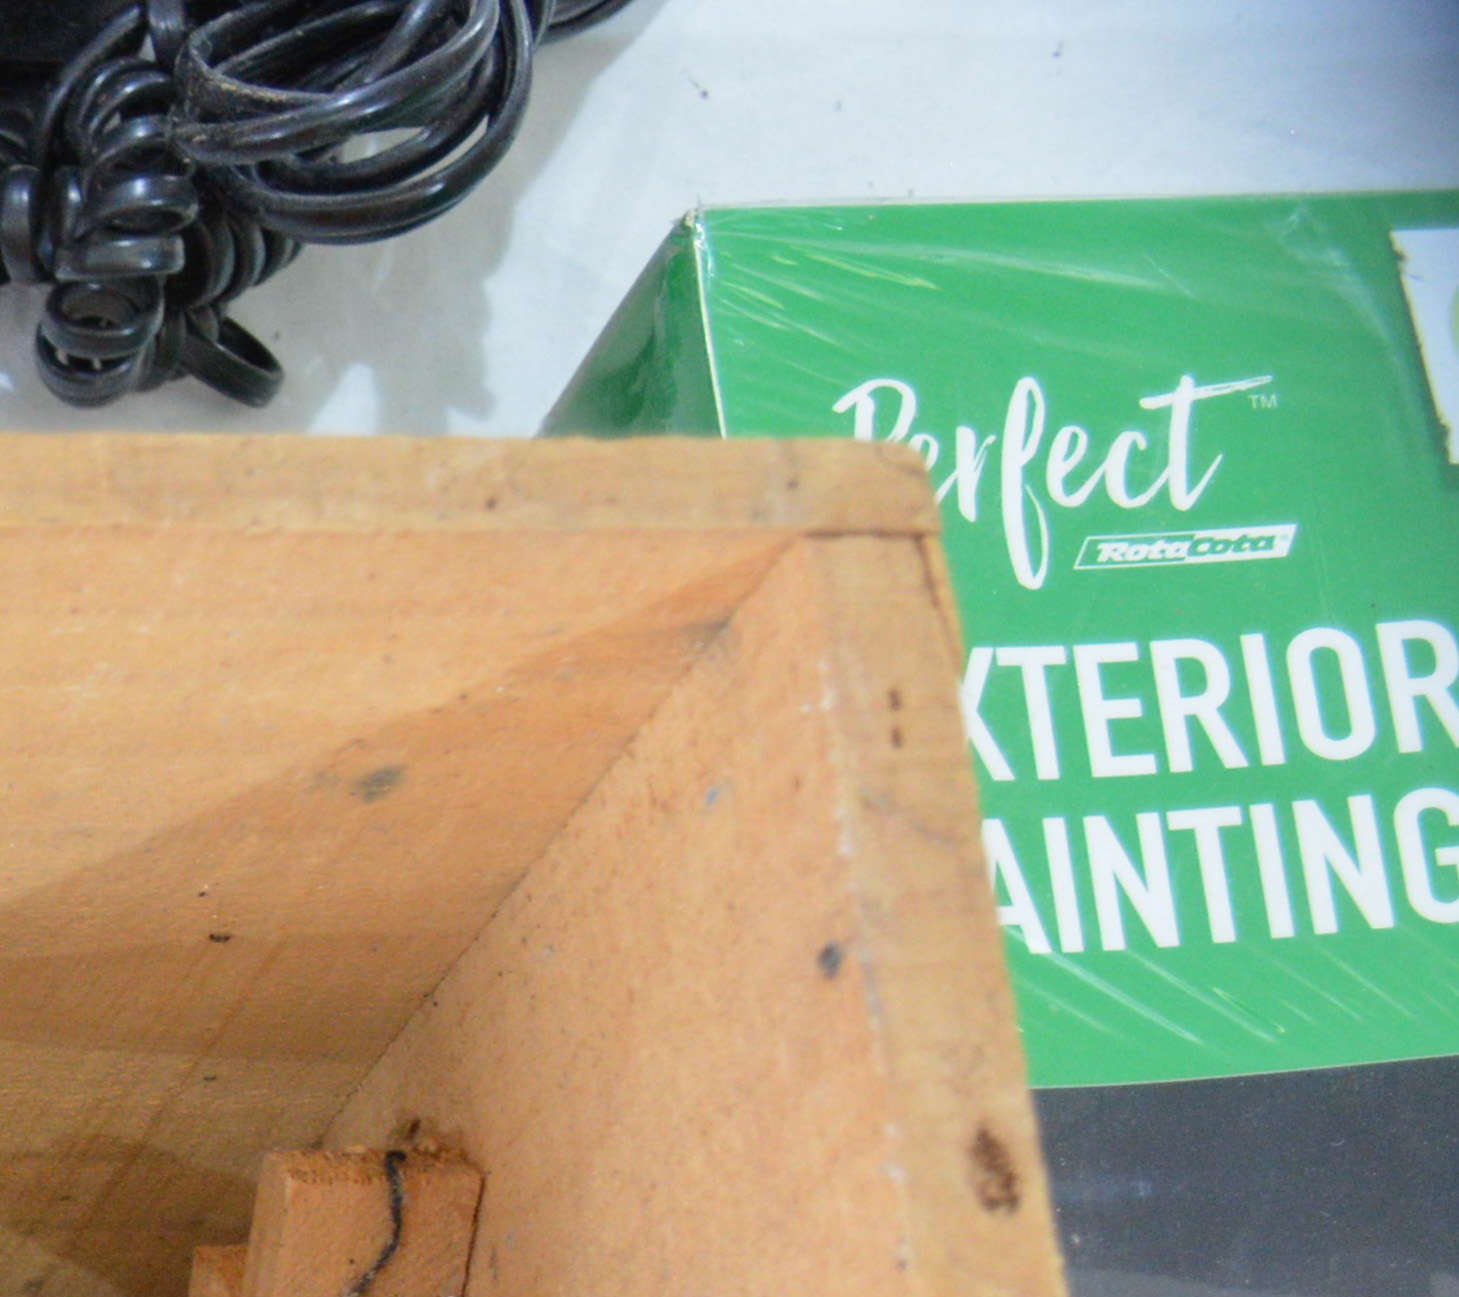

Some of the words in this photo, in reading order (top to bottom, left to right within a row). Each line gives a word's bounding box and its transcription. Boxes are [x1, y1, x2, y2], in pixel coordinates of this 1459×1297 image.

[832, 375, 1272, 589] Perfect
[958, 619, 1459, 781] XTERIOR
[981, 787, 1459, 954] AINTING
